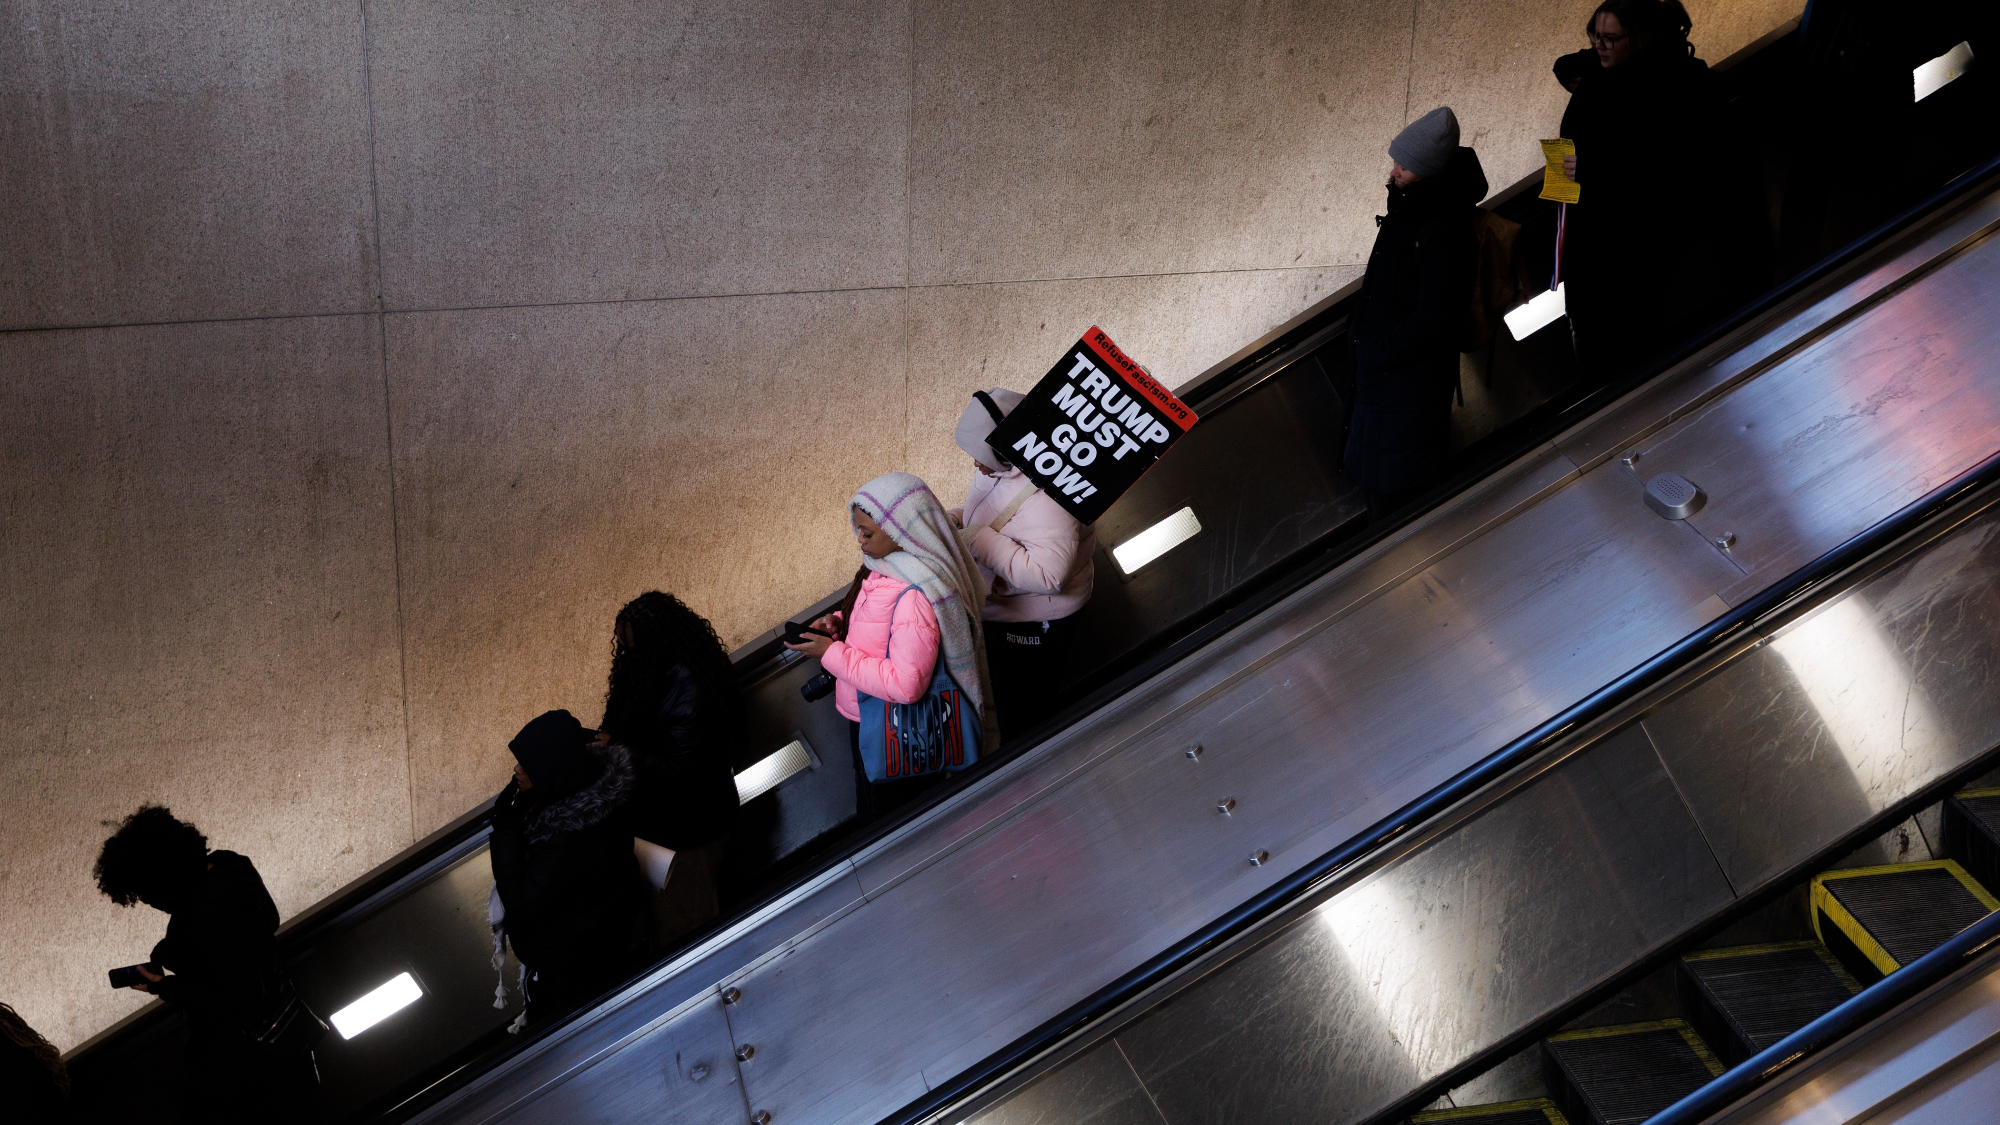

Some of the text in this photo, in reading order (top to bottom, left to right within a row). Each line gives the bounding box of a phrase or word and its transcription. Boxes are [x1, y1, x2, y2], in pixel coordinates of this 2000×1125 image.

[1067, 351, 1170, 445] TRUMP
[1094, 331, 1188, 420] RefuseFascism.org
[1050, 382, 1142, 461] MUST
[1050, 423, 1098, 467] GO
[1011, 431, 1098, 505] NOW!
[884, 689, 964, 777] BISON
